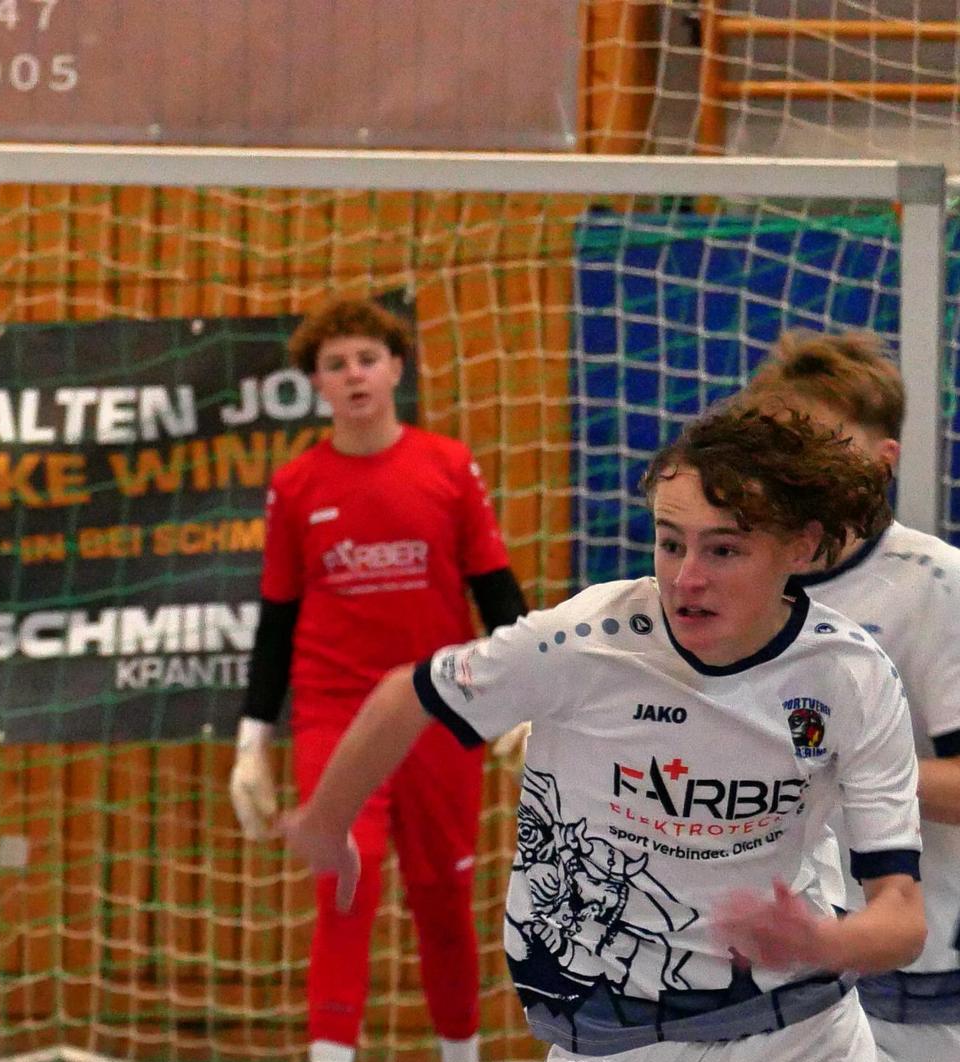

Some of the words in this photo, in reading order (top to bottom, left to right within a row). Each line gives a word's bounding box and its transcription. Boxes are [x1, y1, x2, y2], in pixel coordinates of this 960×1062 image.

[220, 367, 333, 425] JO
[108, 426, 333, 498] WINK
[633, 704, 688, 723] JAKO
